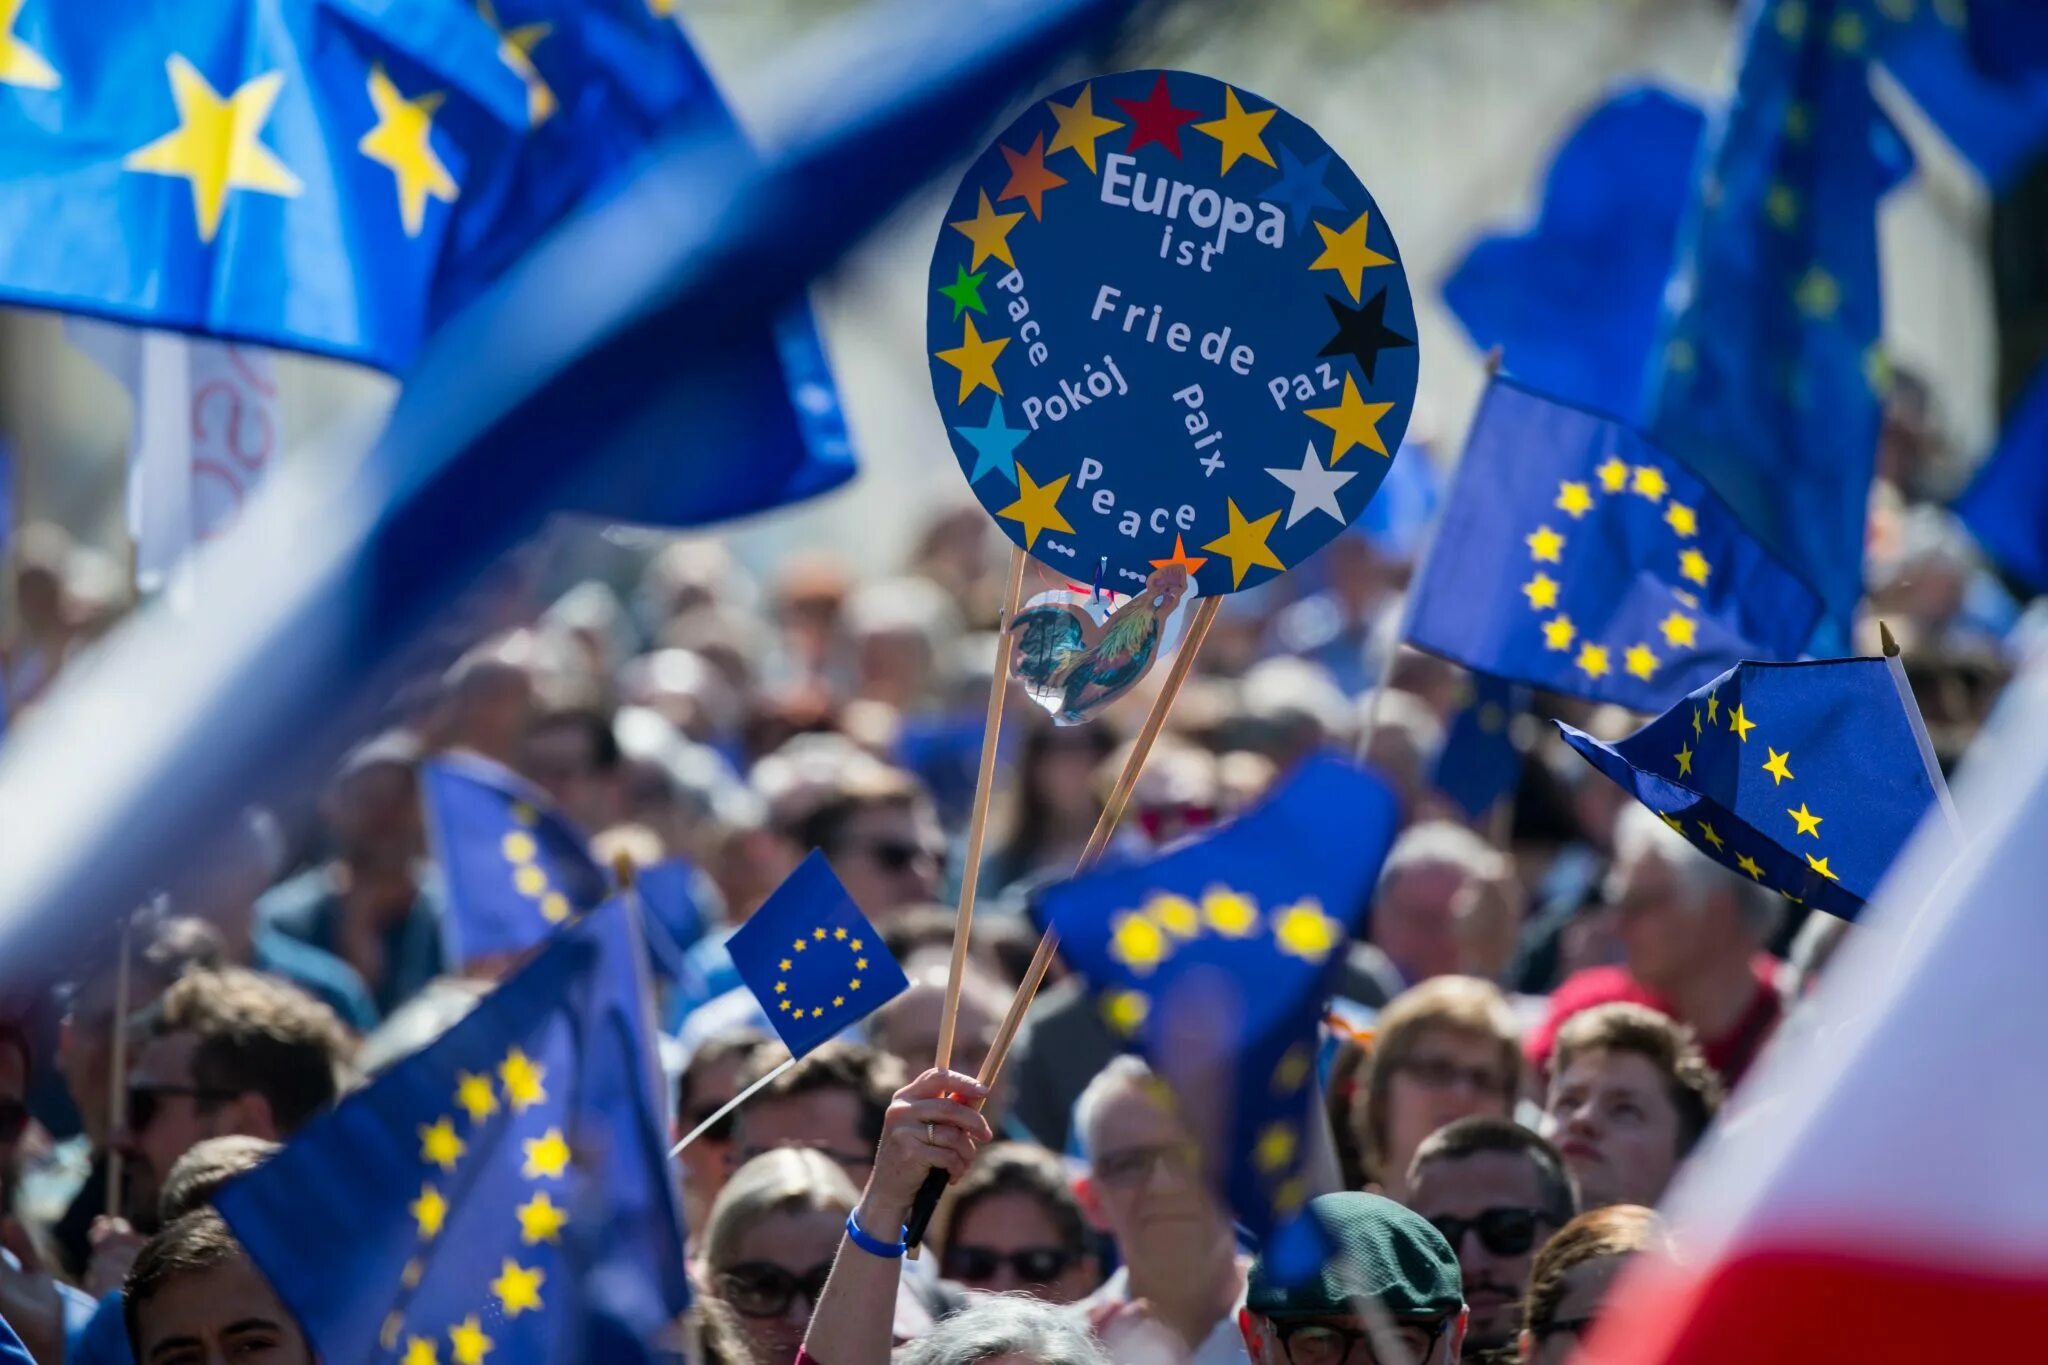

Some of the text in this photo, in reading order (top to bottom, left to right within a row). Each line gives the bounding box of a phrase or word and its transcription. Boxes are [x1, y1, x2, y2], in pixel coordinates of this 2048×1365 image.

[1101, 153, 1285, 254] Europa
[1160, 225, 1220, 272] ist
[996, 268, 1048, 367] Pace
[1091, 285, 1255, 375] Friede
[1172, 383, 1225, 477] Paix
[1267, 362, 1340, 411] Paz
[1076, 457, 1196, 538] Peace
